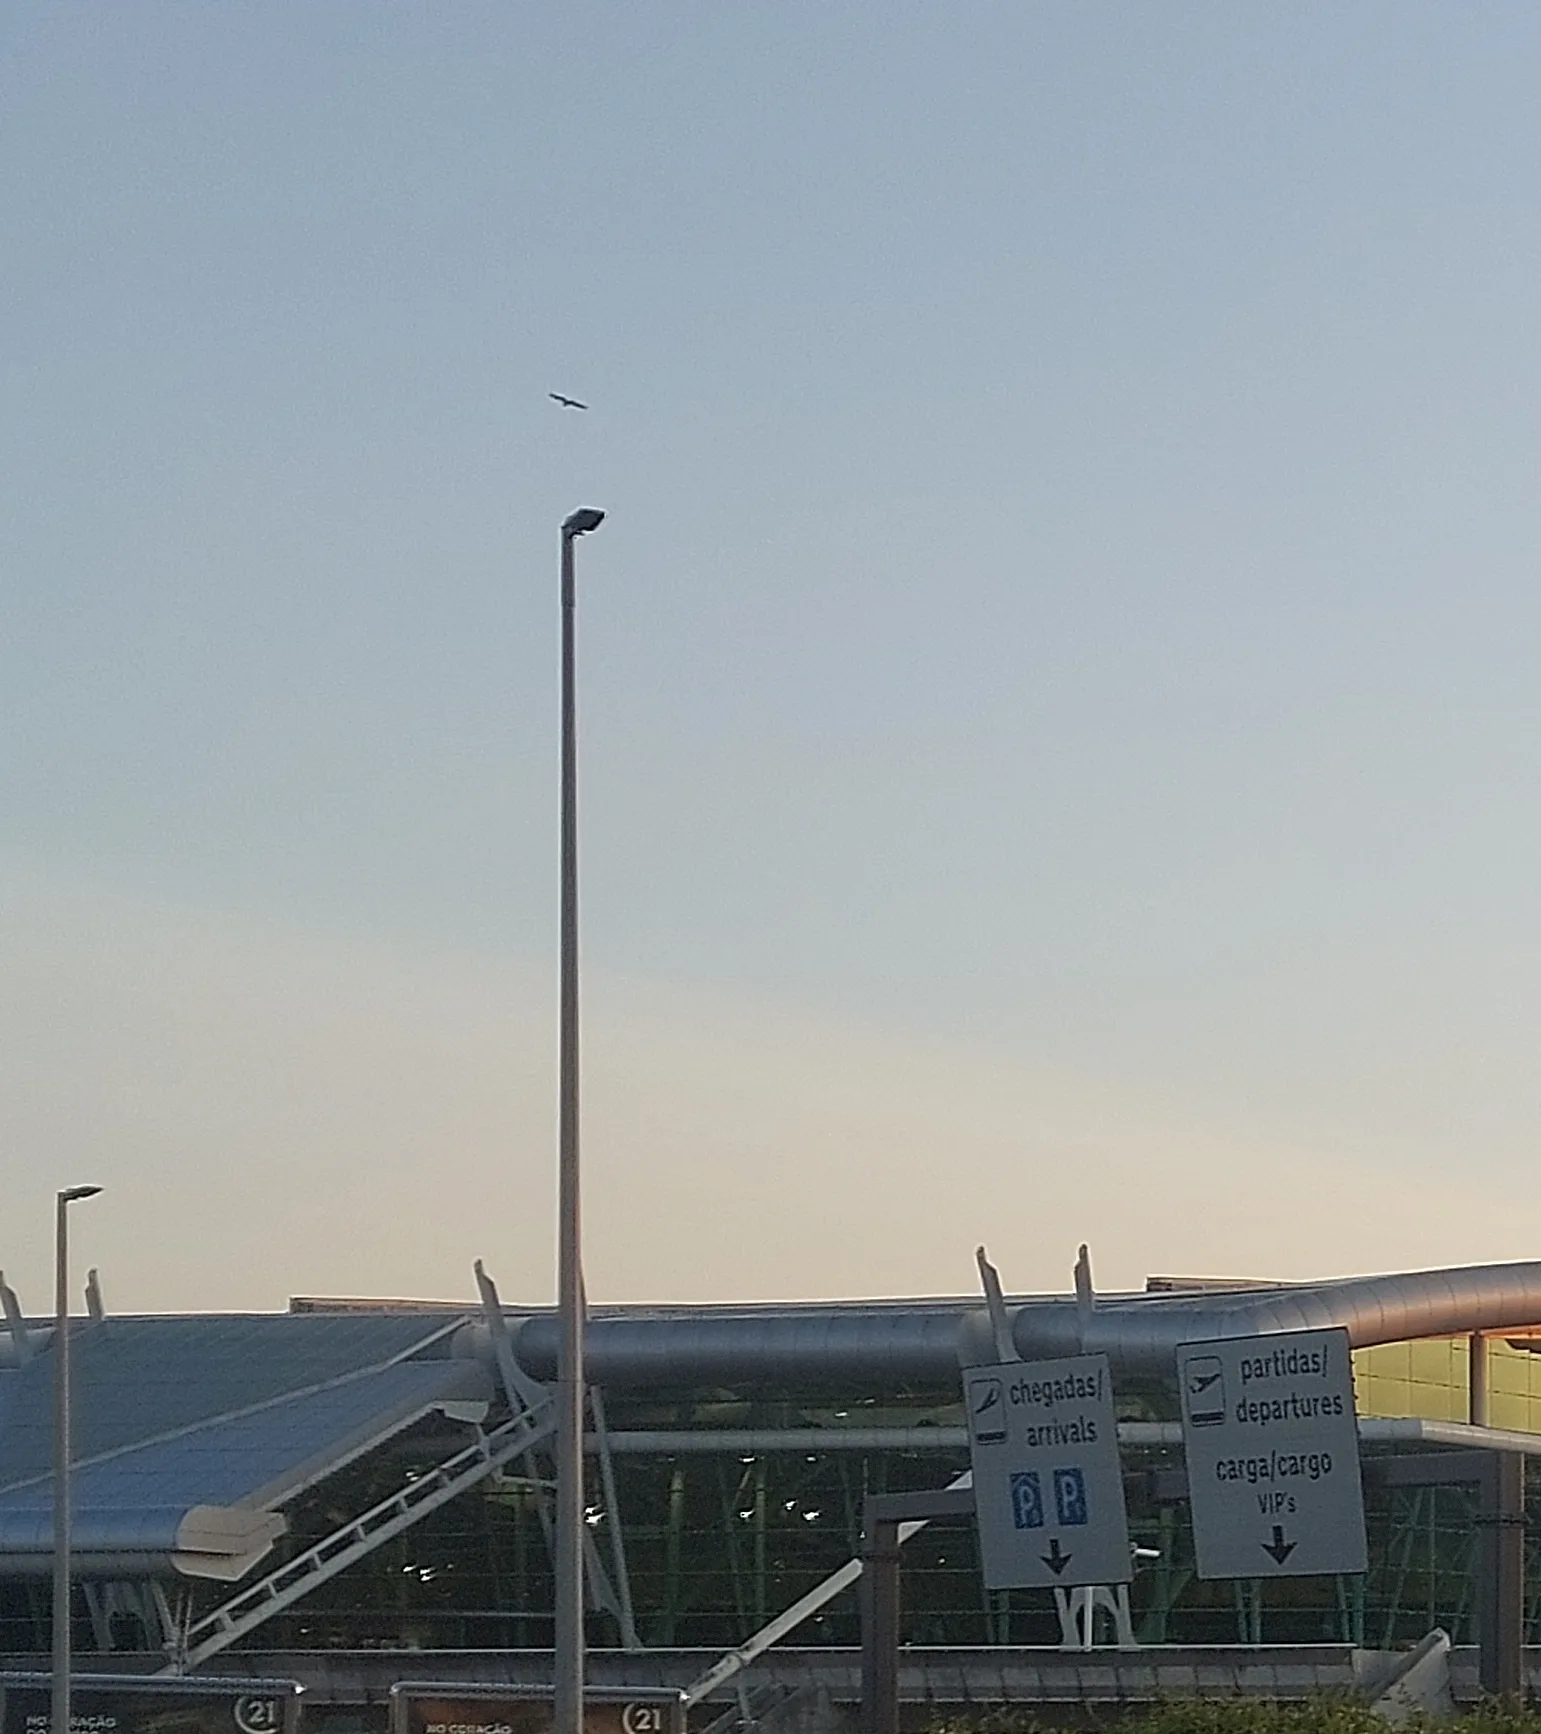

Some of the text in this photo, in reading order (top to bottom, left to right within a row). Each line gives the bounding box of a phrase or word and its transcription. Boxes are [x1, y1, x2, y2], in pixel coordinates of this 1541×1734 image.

[1240, 1344, 1328, 1385] partidas/
[1009, 1368, 1103, 1408] chegadas/
[1236, 1392, 1344, 1426] departures
[1027, 1415, 1099, 1447] arrivals
[1216, 1450, 1333, 1484] carga/cargo
